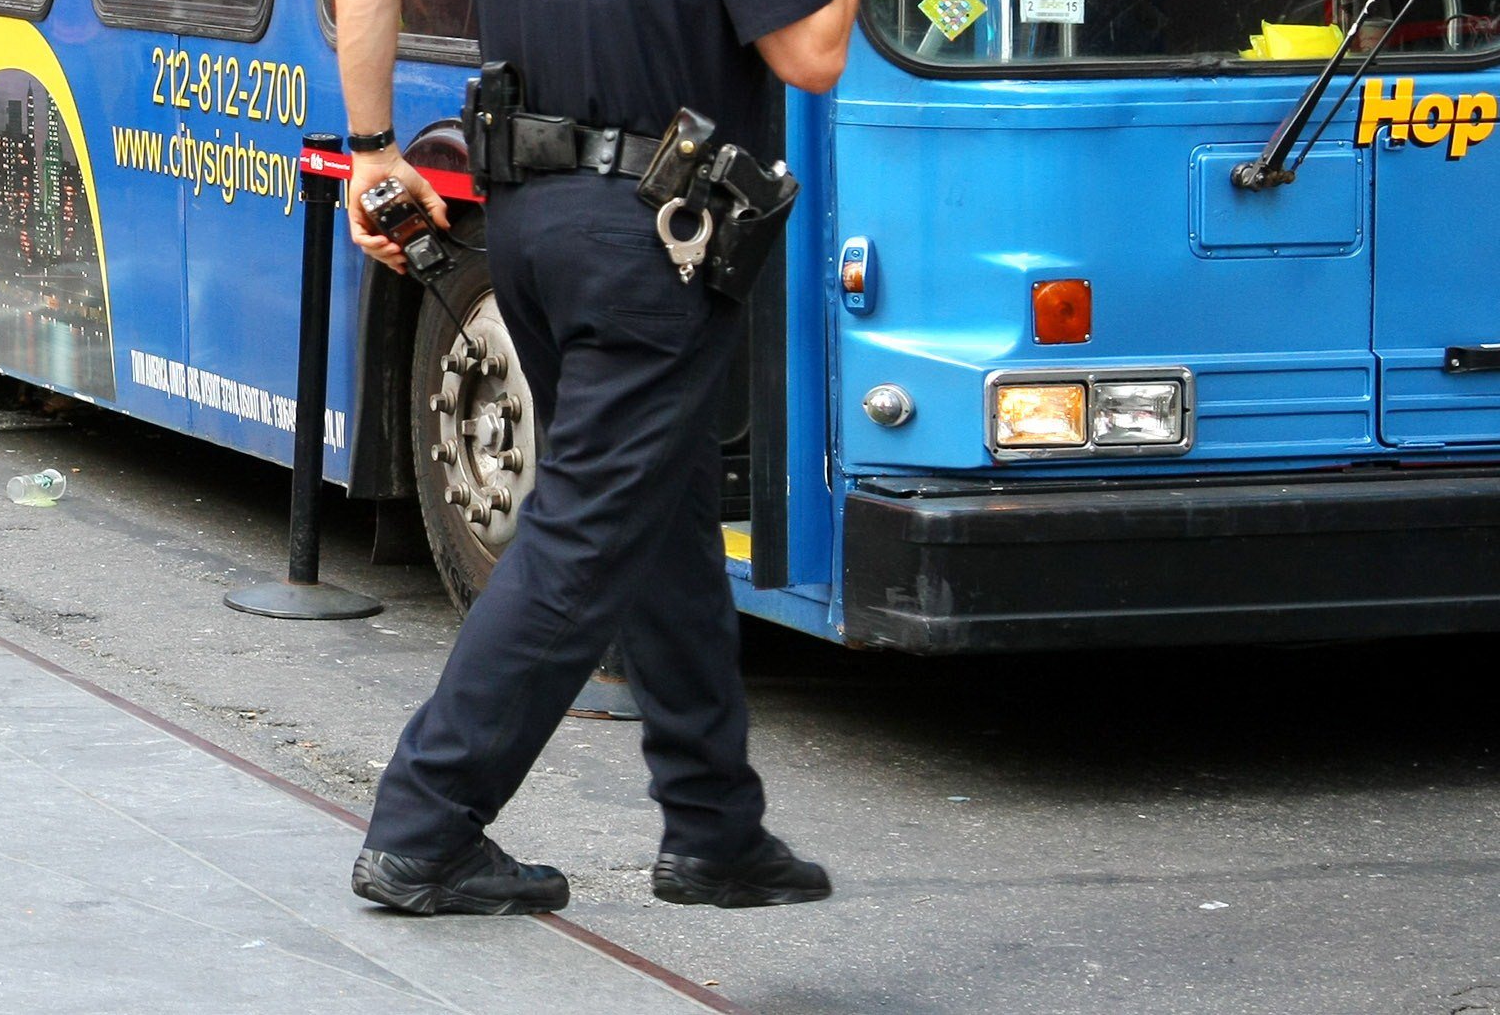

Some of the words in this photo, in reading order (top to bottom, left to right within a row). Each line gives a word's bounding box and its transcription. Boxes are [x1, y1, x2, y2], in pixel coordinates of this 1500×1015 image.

[1028, 1, 1033, 11] 2
[1066, 1, 1077, 12] 15
[152, 47, 306, 126] 212-812-2700
[1355, 77, 1498, 159] Hop
